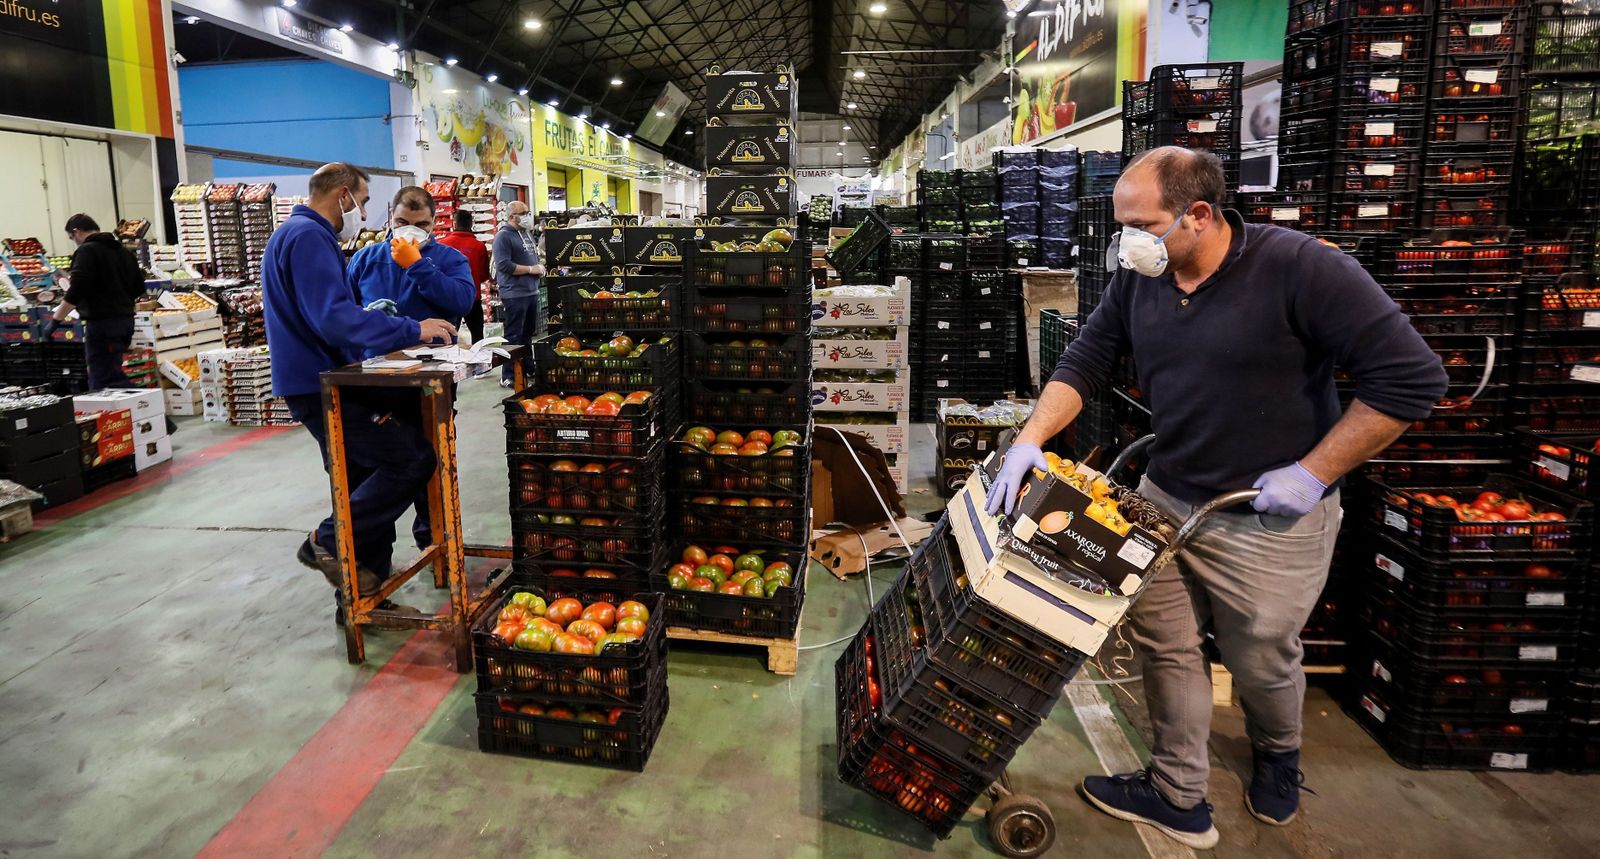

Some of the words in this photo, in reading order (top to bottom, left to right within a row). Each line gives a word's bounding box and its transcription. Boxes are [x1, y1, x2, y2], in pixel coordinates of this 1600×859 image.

[545, 119, 585, 156] FRUTAS
[855, 303, 875, 314] Siles
[855, 346, 873, 357] Siles
[855, 390, 874, 401] Siles
[1064, 529, 1107, 557] AXARQUÍA
[1077, 543, 1103, 562] Tropical
[1039, 556, 1059, 570] fruit
